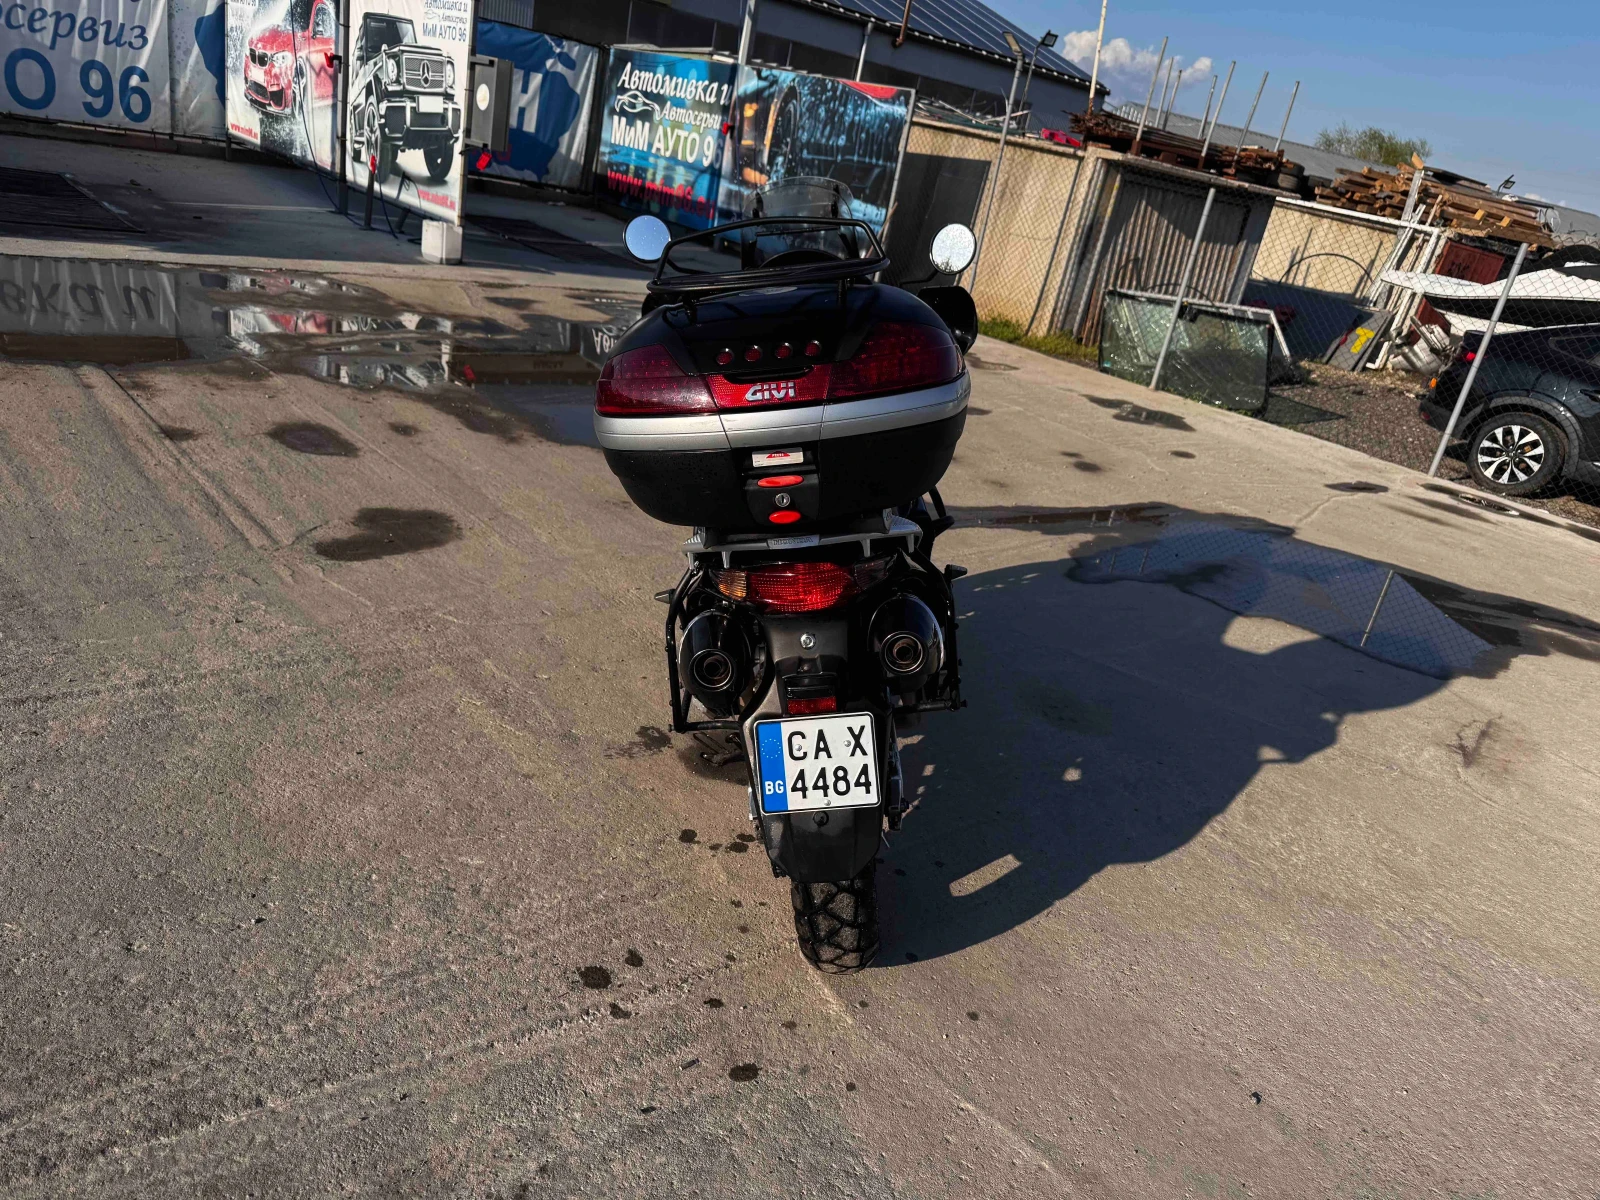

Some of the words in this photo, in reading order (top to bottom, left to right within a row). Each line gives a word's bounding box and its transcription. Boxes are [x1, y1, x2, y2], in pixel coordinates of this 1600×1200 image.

[0, 3, 149, 51] сервиз
[438, 24, 457, 41] АУТО
[458, 27, 467, 42] 96
[80, 59, 152, 123] 96
[617, 62, 717, 103] Автомивка
[719, 83, 733, 105] и
[611, 115, 650, 152] МиМ
[652, 125, 699, 163] АУТО
[702, 135, 724, 170] 96
[607, 169, 715, 220] www.mim96.eu
[773, 536, 814, 546] HONDA
[787, 728, 832, 761] CA
[846, 725, 869, 757] X
[764, 780, 785, 795] BG
[790, 763, 872, 799] 4484
